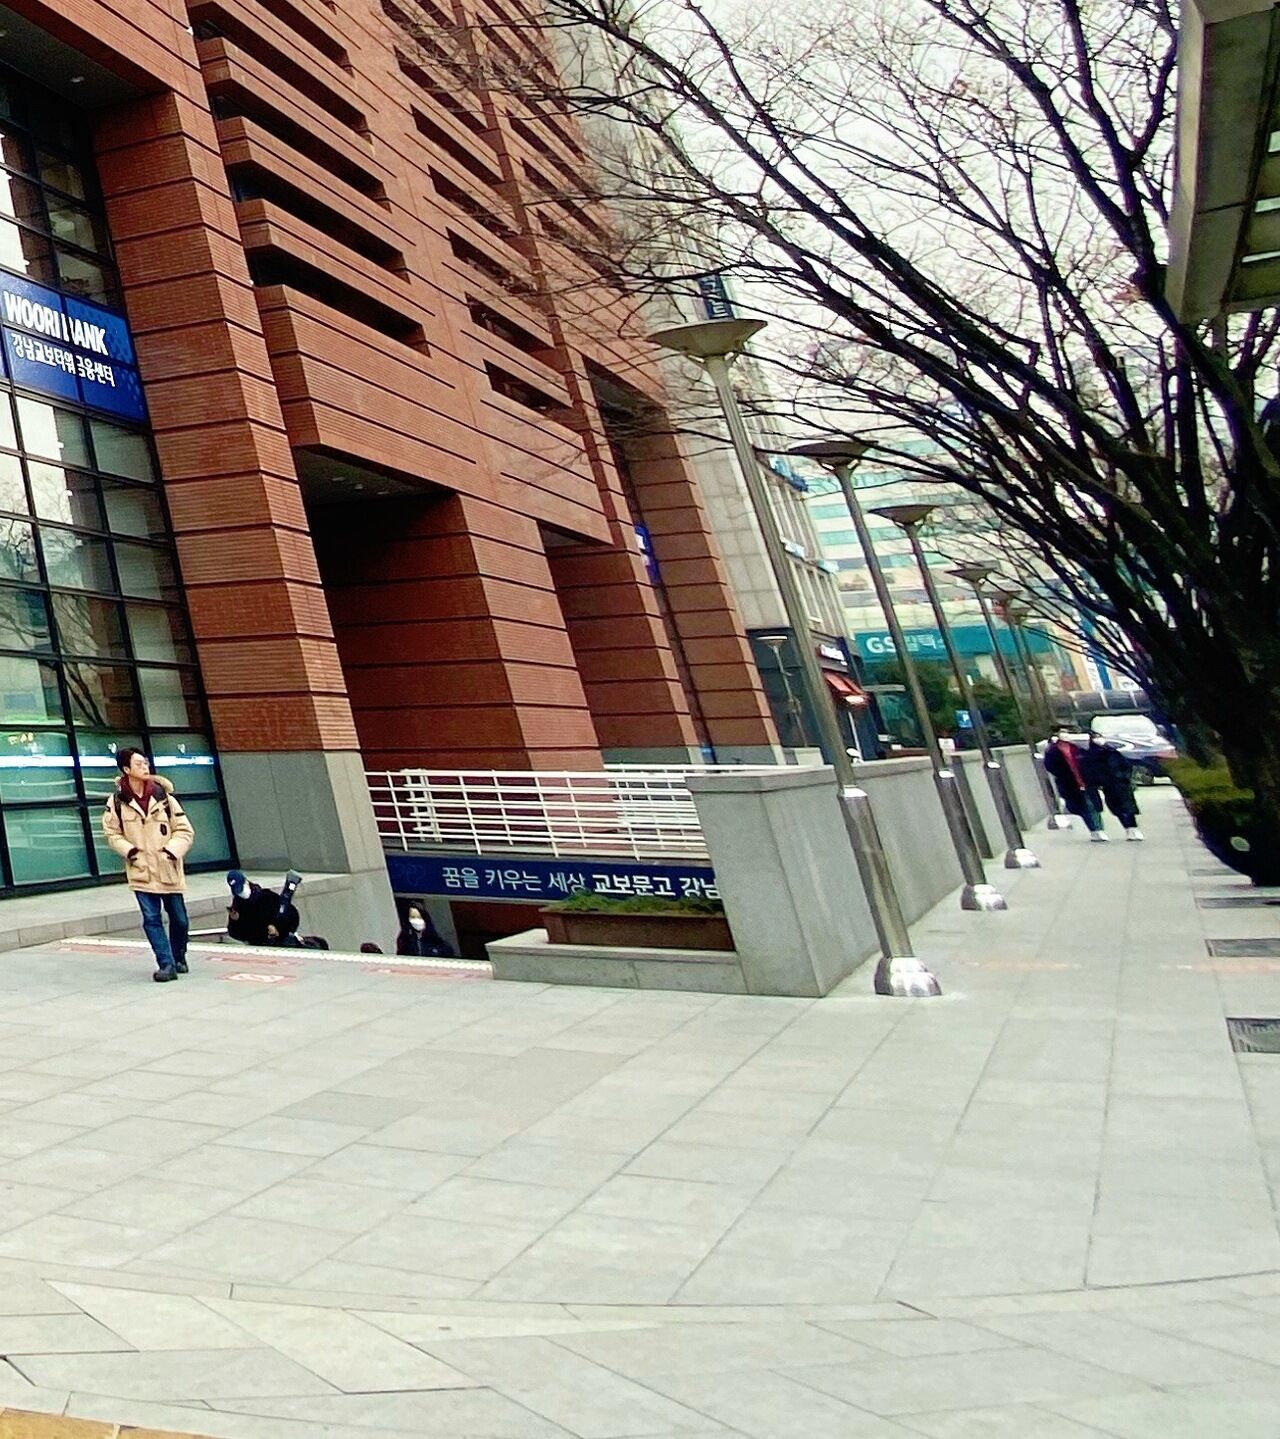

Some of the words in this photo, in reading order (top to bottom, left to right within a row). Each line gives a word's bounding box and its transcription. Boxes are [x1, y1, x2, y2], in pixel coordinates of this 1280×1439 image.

[3, 290, 61, 340] WOORI
[10, 332, 77, 375] 강남교보타워
[75, 355, 116, 387] 금융센터
[442, 866, 480, 889] 꿈을
[485, 868, 543, 892] 키우는
[547, 871, 587, 894] 세상
[591, 874, 677, 897] 교보문고
